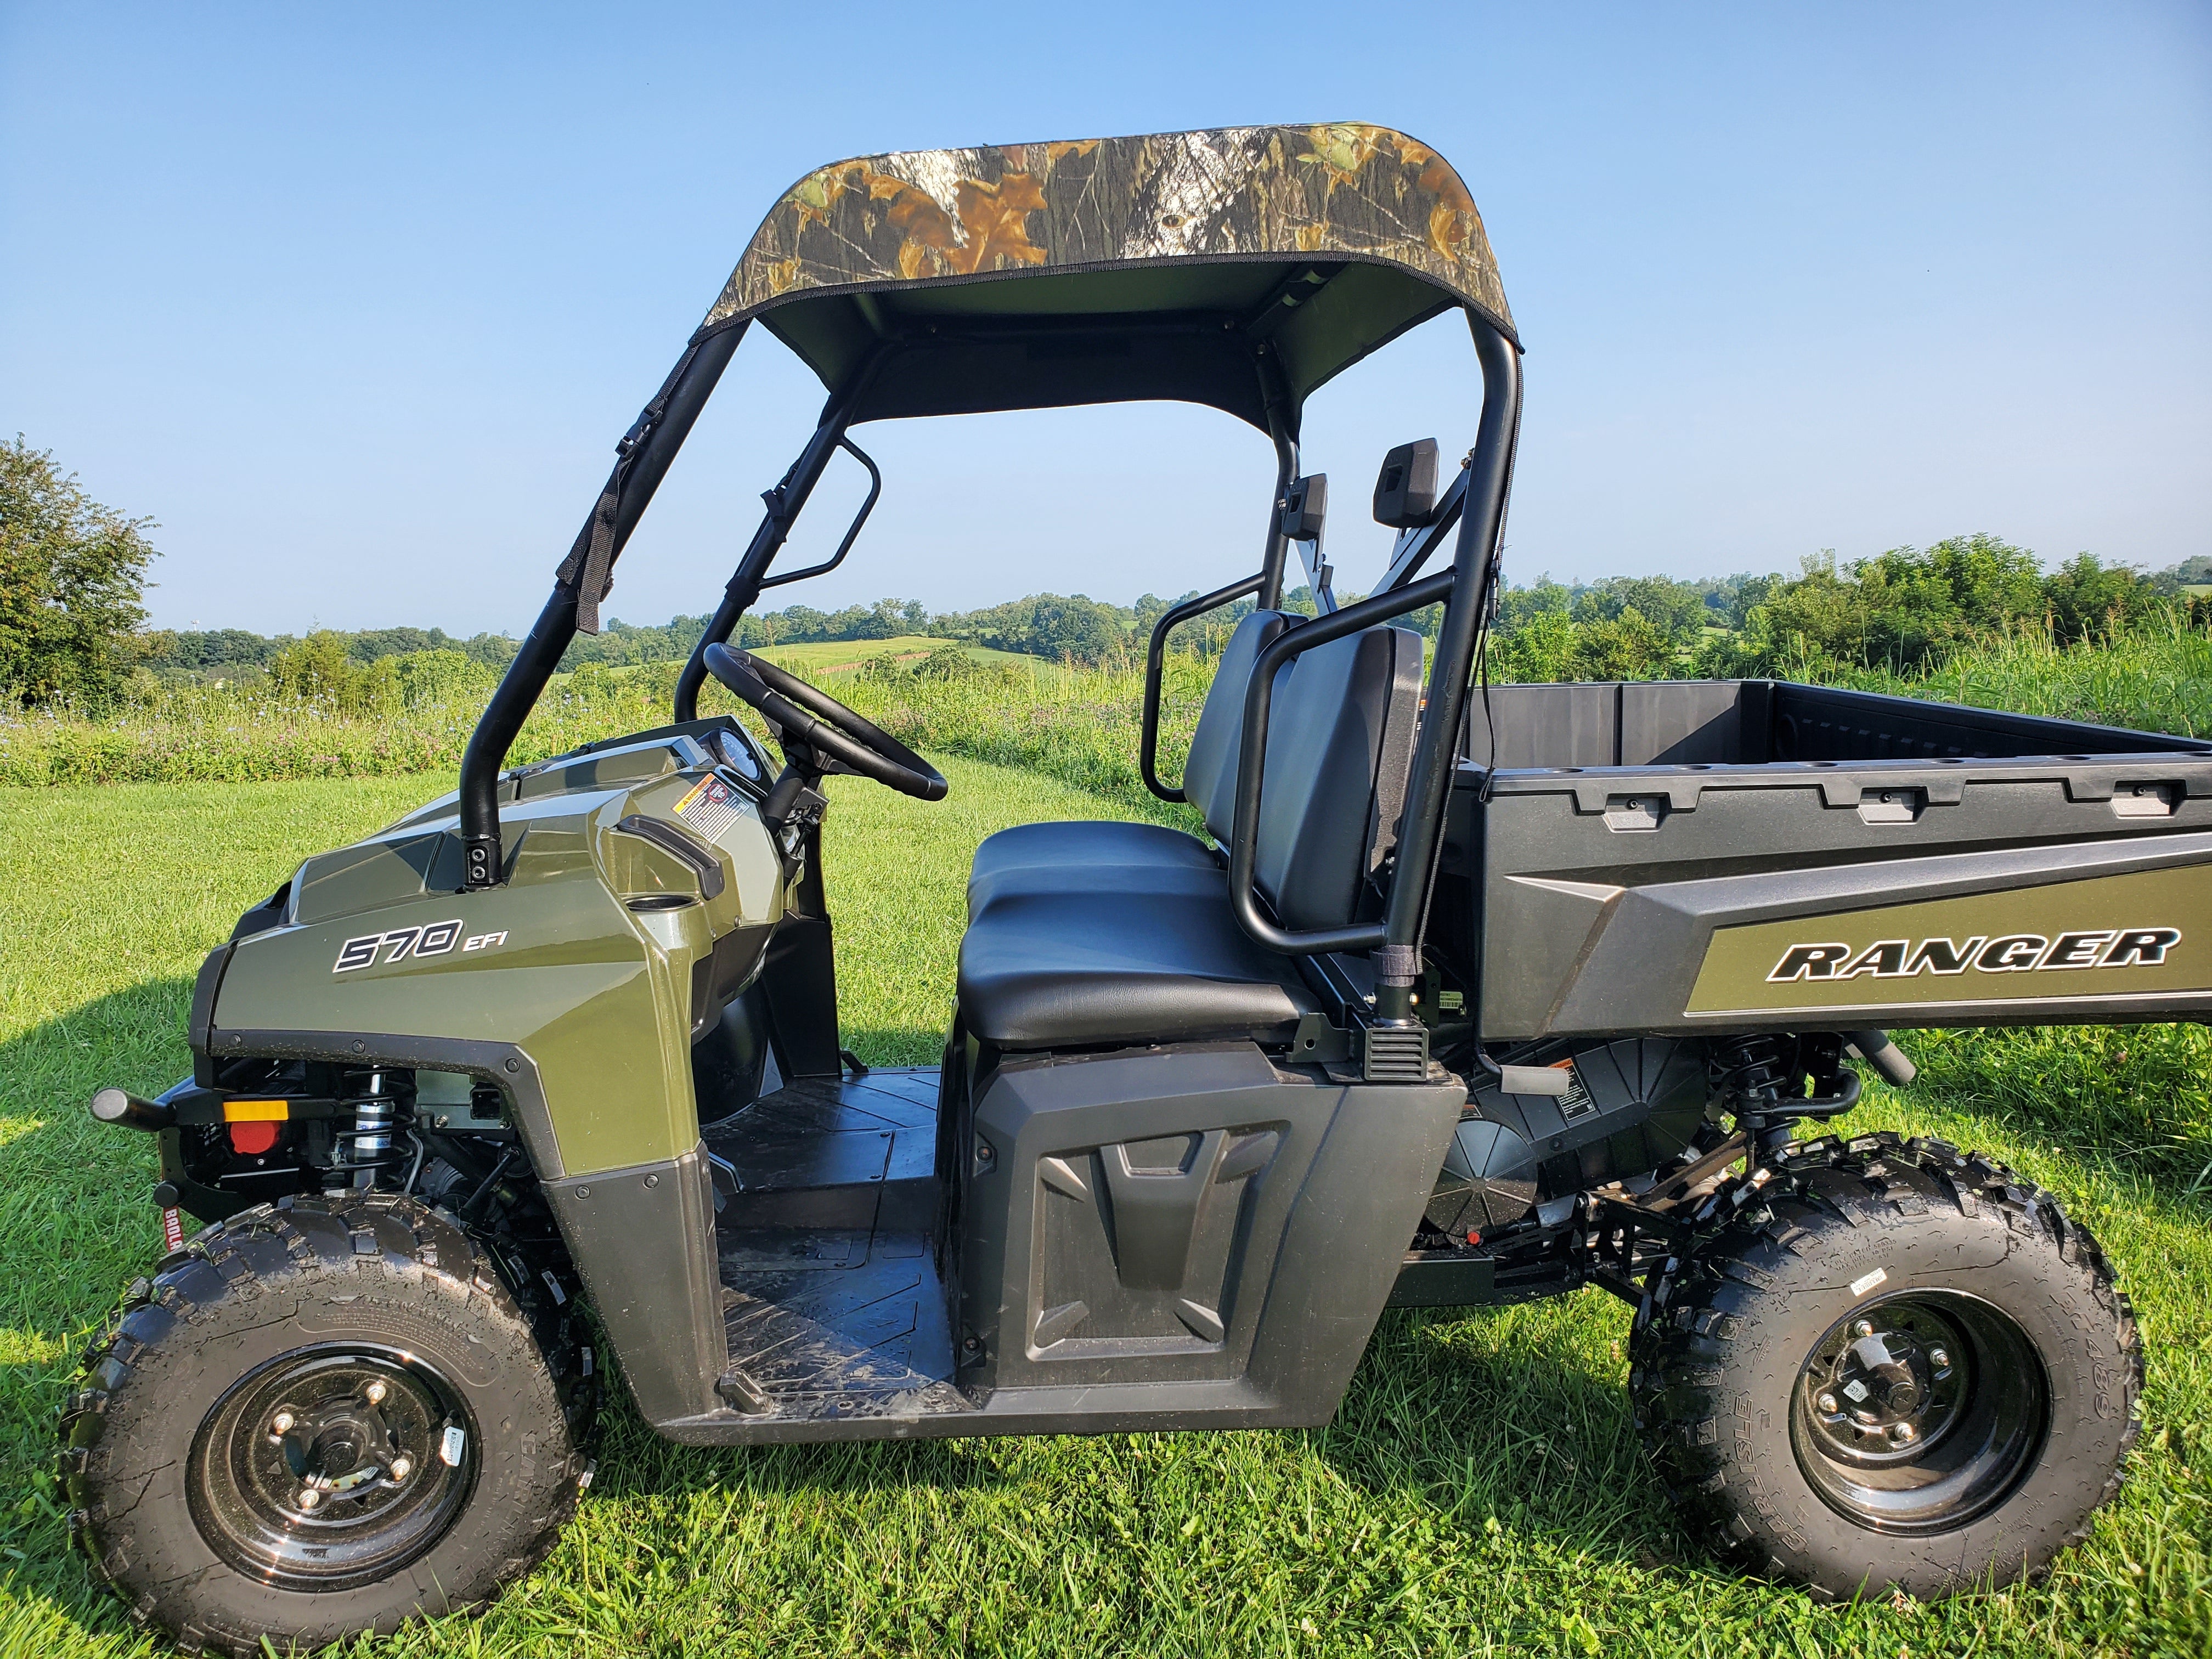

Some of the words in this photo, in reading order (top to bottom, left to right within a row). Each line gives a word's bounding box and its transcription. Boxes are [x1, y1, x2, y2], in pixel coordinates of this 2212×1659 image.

[687, 781, 707, 801] WARNING
[332, 918, 464, 973] 570
[462, 929, 510, 952] EFI
[1765, 927, 2183, 983] RANGER
[1734, 1395, 1810, 1551] CARLISLE
